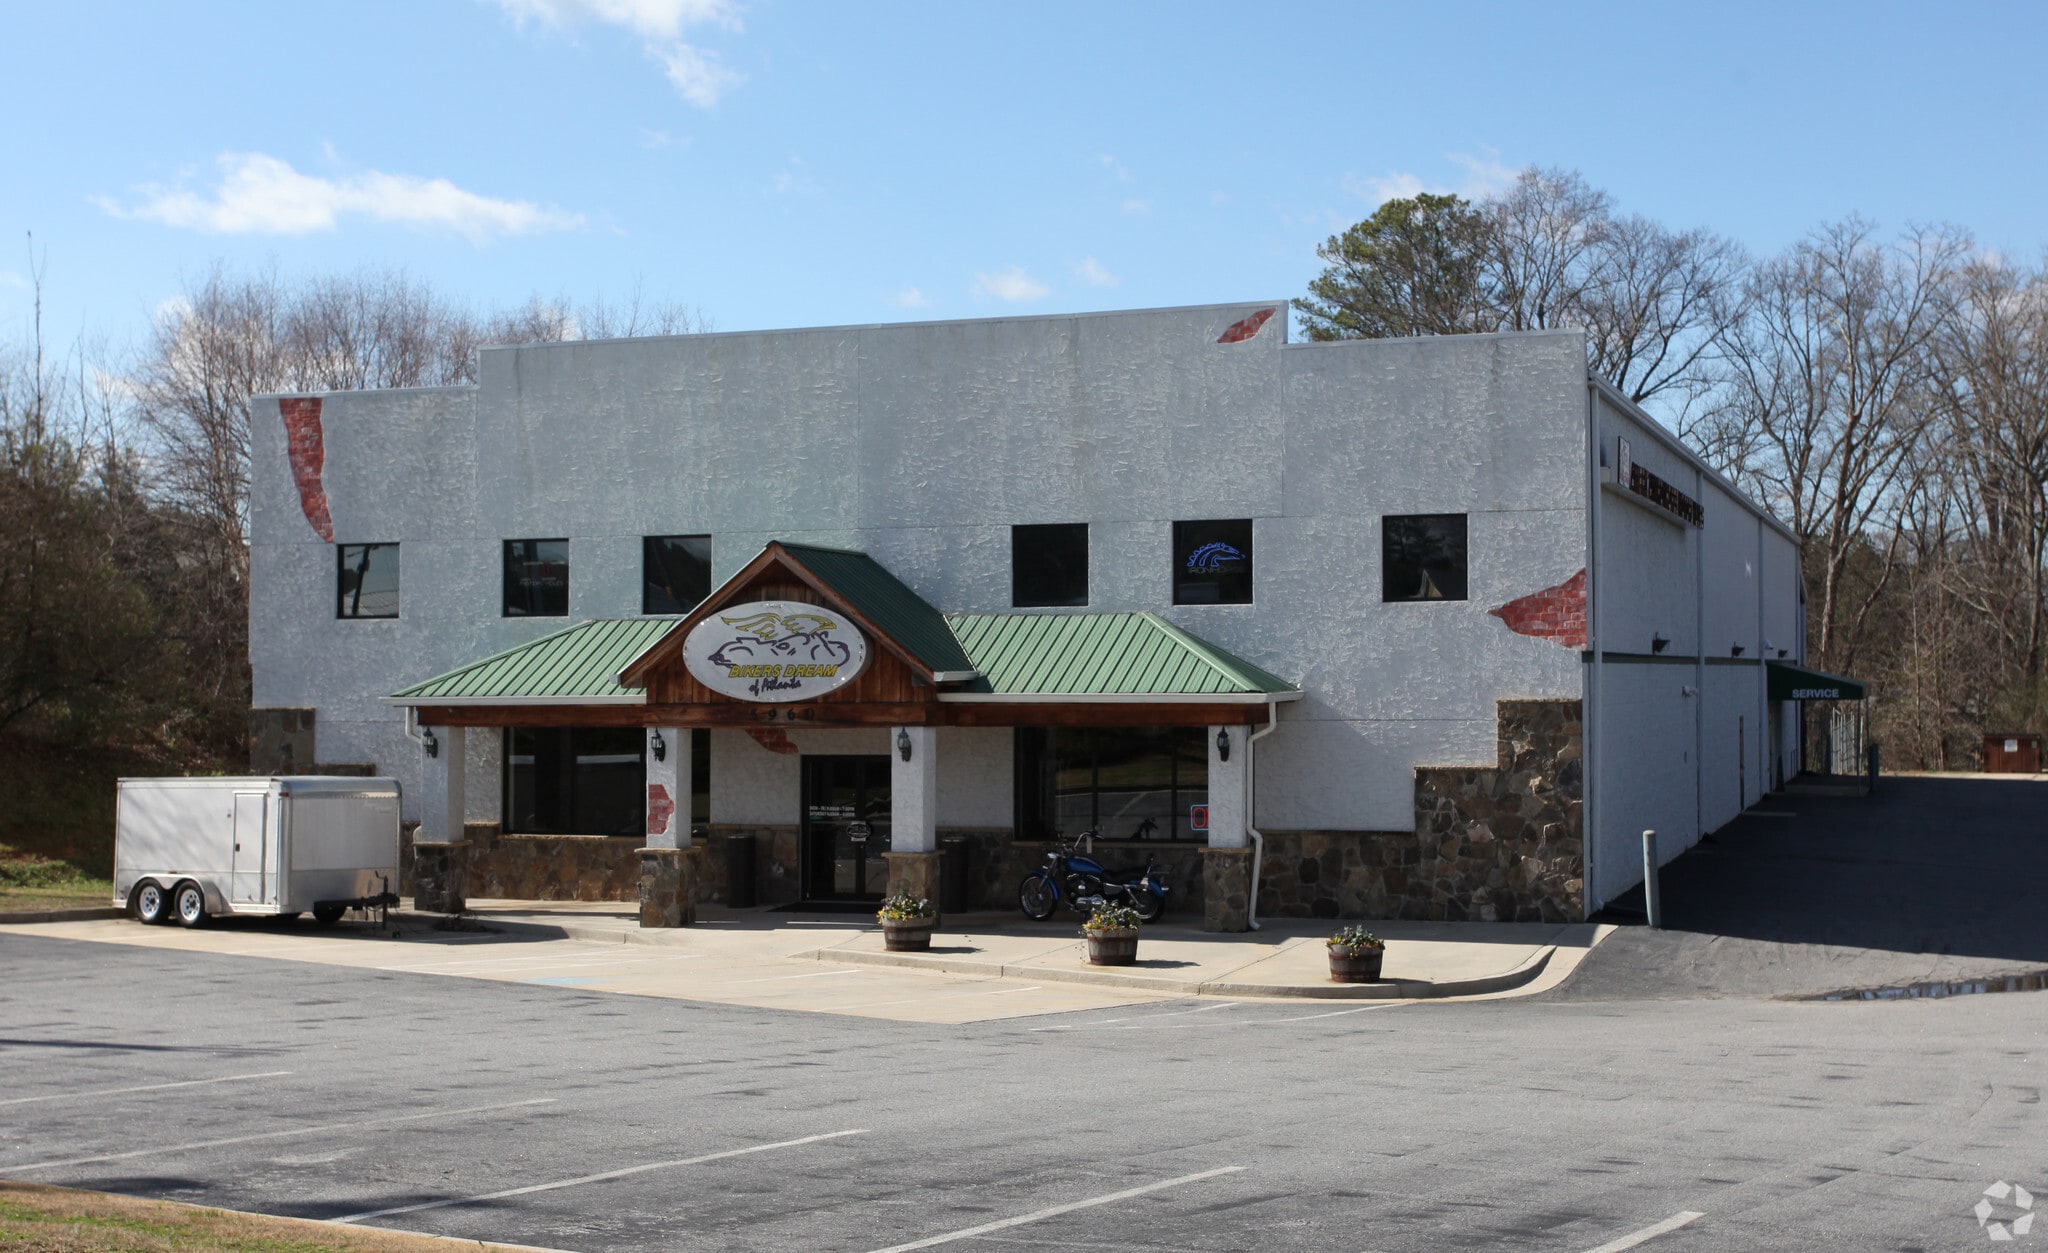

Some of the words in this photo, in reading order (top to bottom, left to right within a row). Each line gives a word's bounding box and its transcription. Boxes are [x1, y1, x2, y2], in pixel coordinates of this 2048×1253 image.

[728, 663, 782, 678] BIKERS
[783, 663, 839, 678] DREAM
[748, 678, 759, 697] of
[761, 676, 802, 692] Atlanta
[1791, 688, 1840, 699] SERVICE
